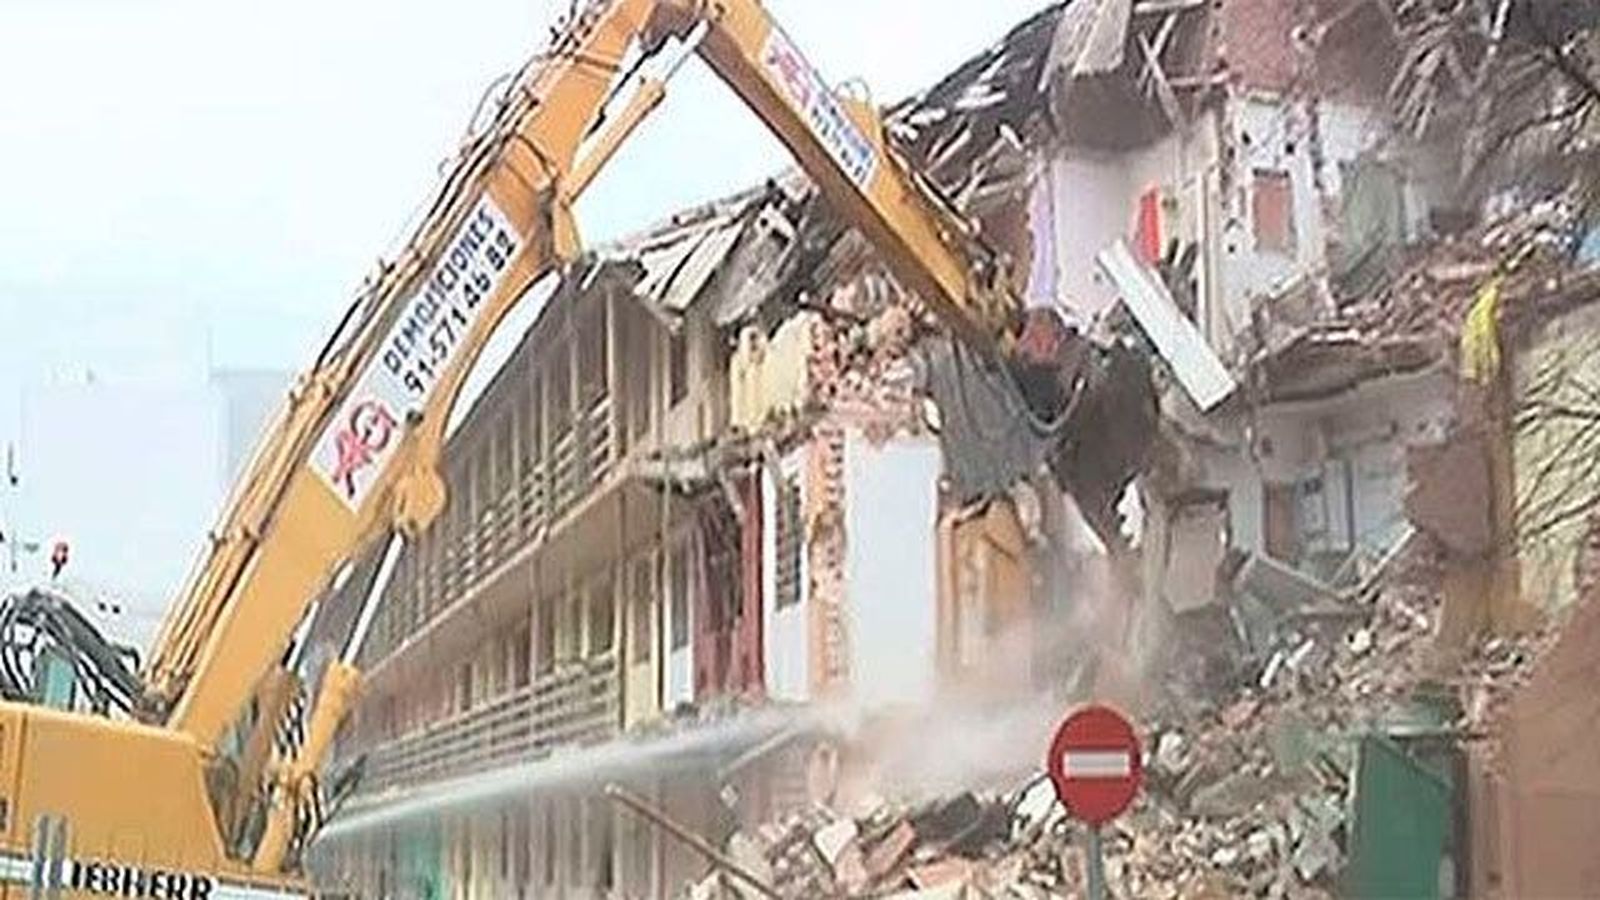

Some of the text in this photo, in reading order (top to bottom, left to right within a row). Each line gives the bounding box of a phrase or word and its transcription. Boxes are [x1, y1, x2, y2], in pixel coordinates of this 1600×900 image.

[383, 207, 495, 375] DEMOLICIONES
[403, 308, 467, 394] 91-571
[463, 271, 492, 309] 46
[62, 860, 213, 900] IEBHERR
